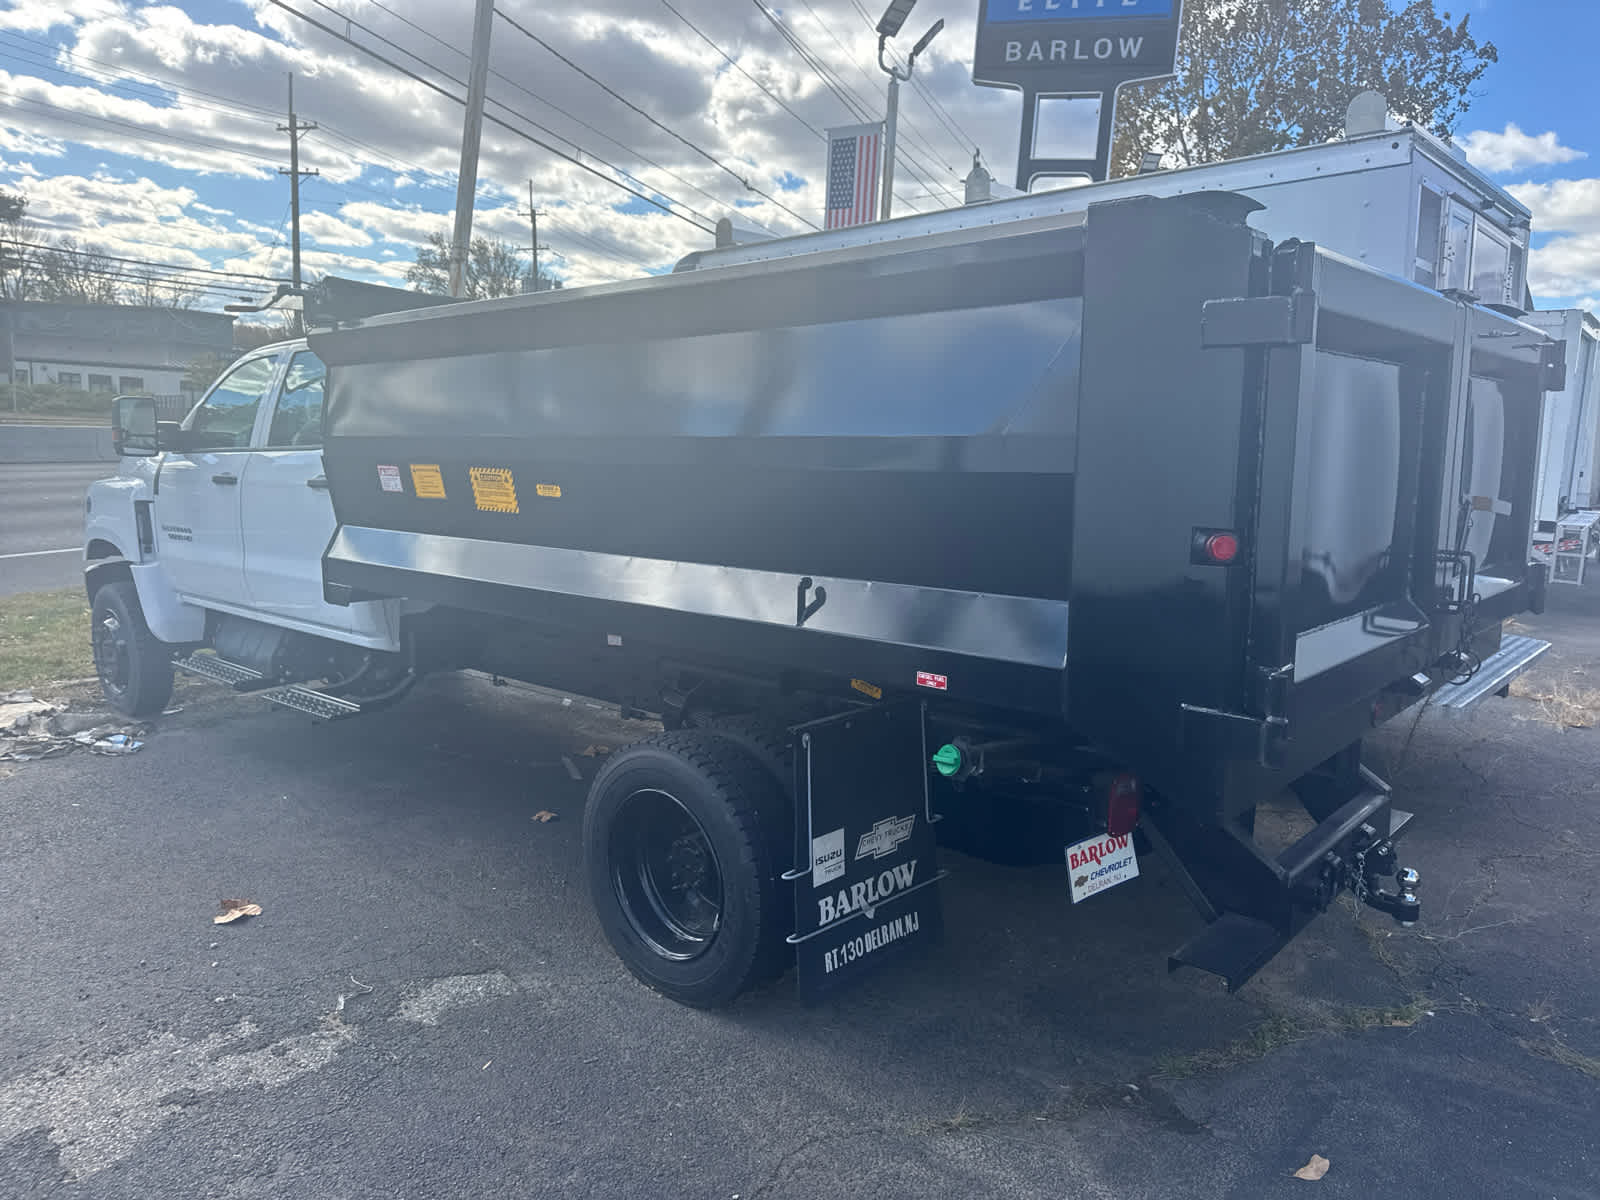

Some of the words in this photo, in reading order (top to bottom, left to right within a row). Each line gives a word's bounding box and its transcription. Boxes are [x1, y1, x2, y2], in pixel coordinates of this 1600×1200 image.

[1005, 37, 1144, 62] BARLOW
[815, 848, 842, 865] ISUZU
[1069, 833, 1129, 870] BARLOW
[1090, 856, 1133, 881] CHEVROLET
[818, 860, 917, 926] BARLOW
[824, 937, 864, 973] RT.130
